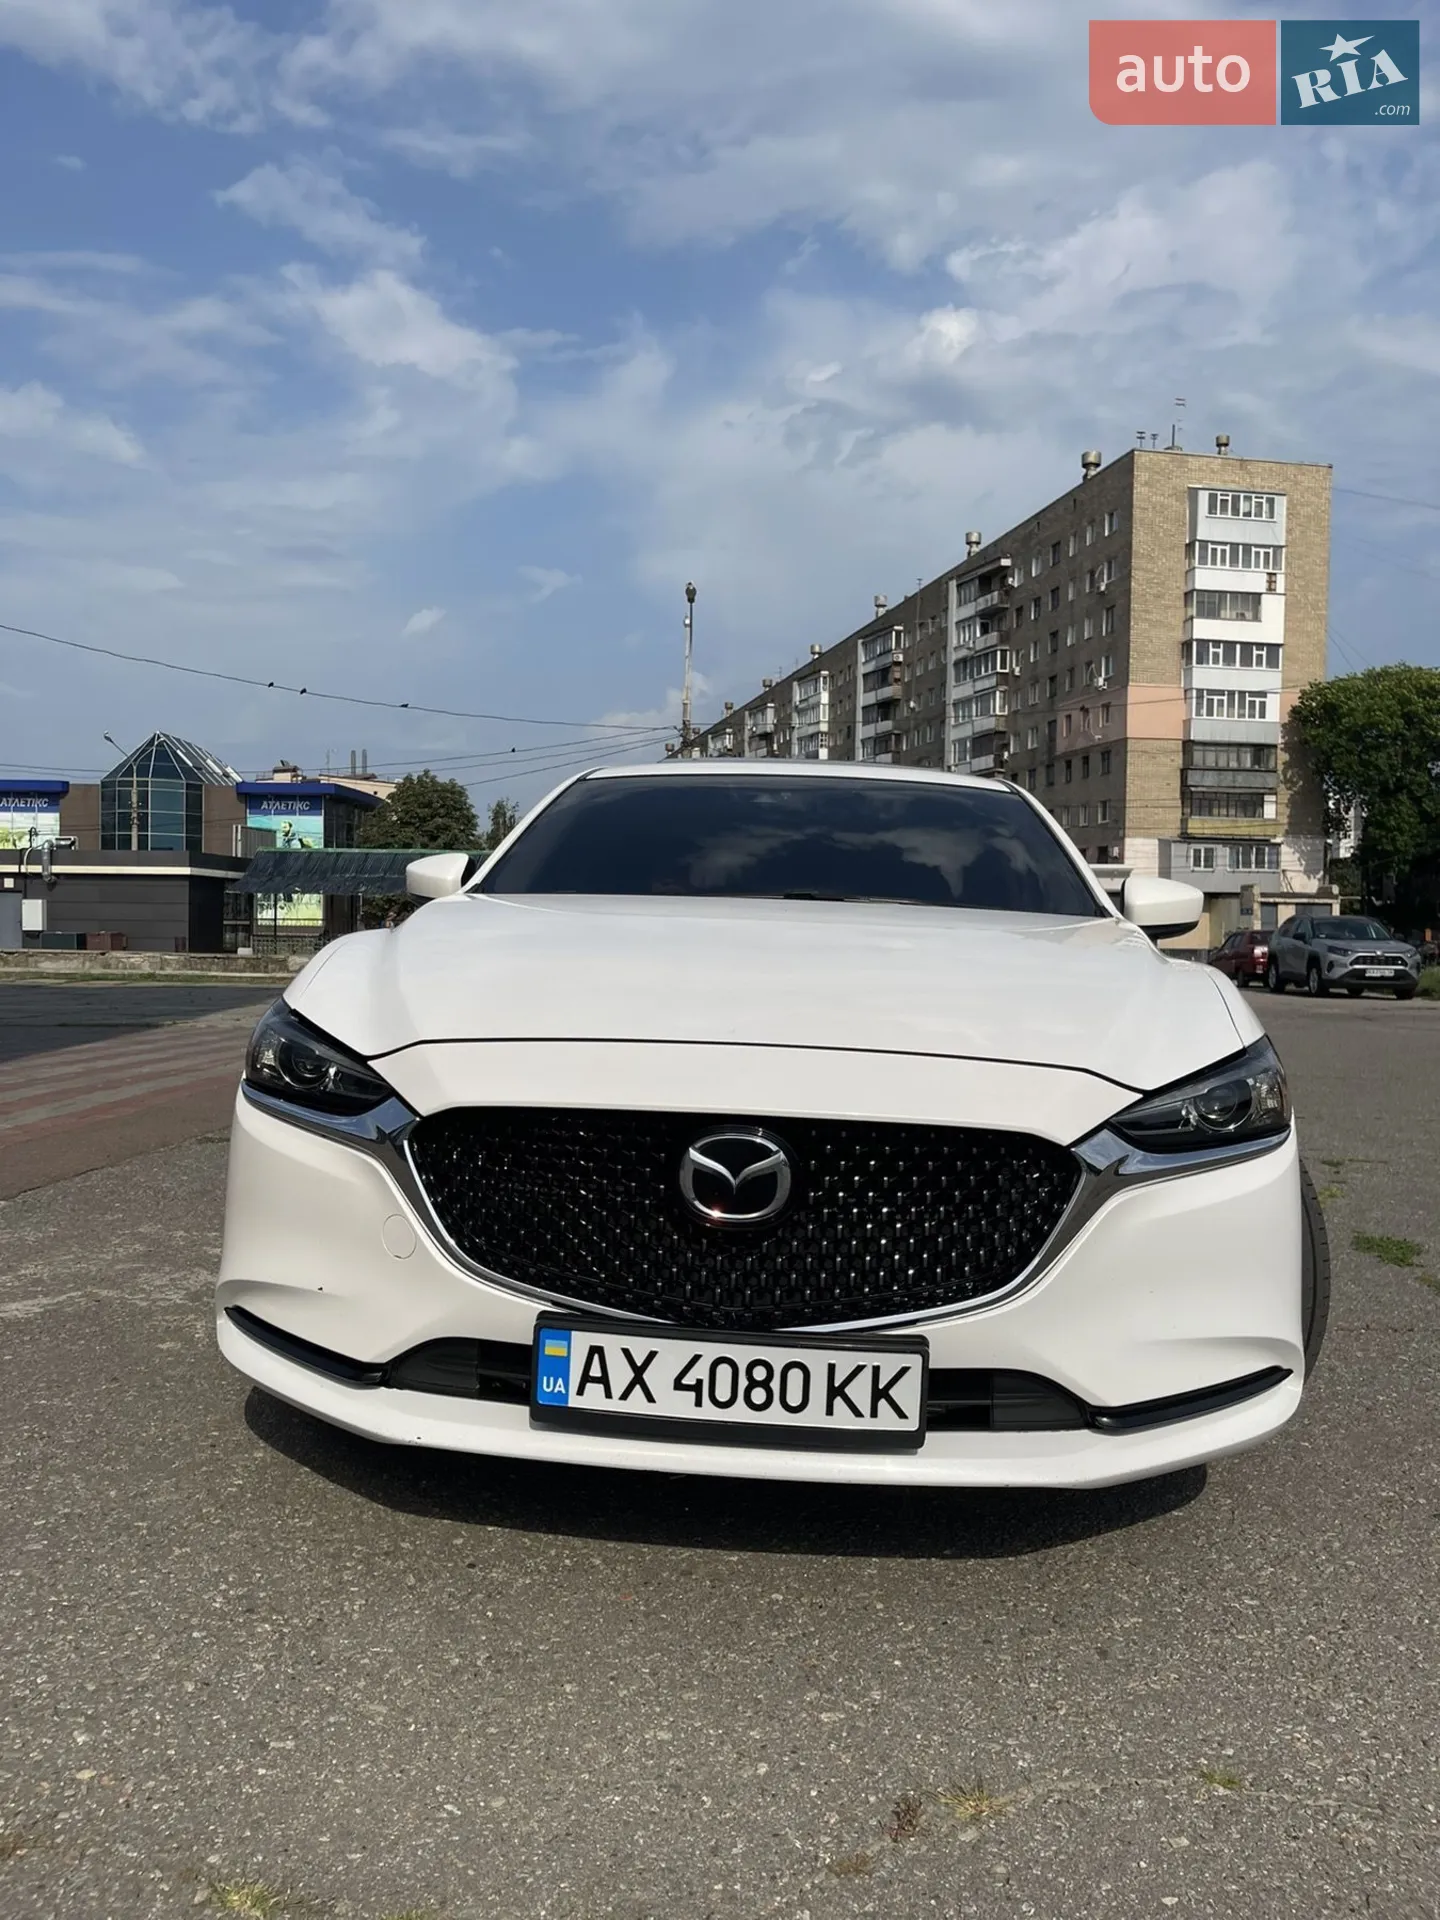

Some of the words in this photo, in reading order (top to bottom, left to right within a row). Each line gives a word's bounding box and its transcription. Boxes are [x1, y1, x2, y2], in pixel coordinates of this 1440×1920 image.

[260, 800, 311, 811] АТЛЕТІКС
[542, 1376, 566, 1394] UA
[575, 1344, 659, 1404] AX
[673, 1353, 811, 1414] 4080
[825, 1361, 913, 1420] KK
